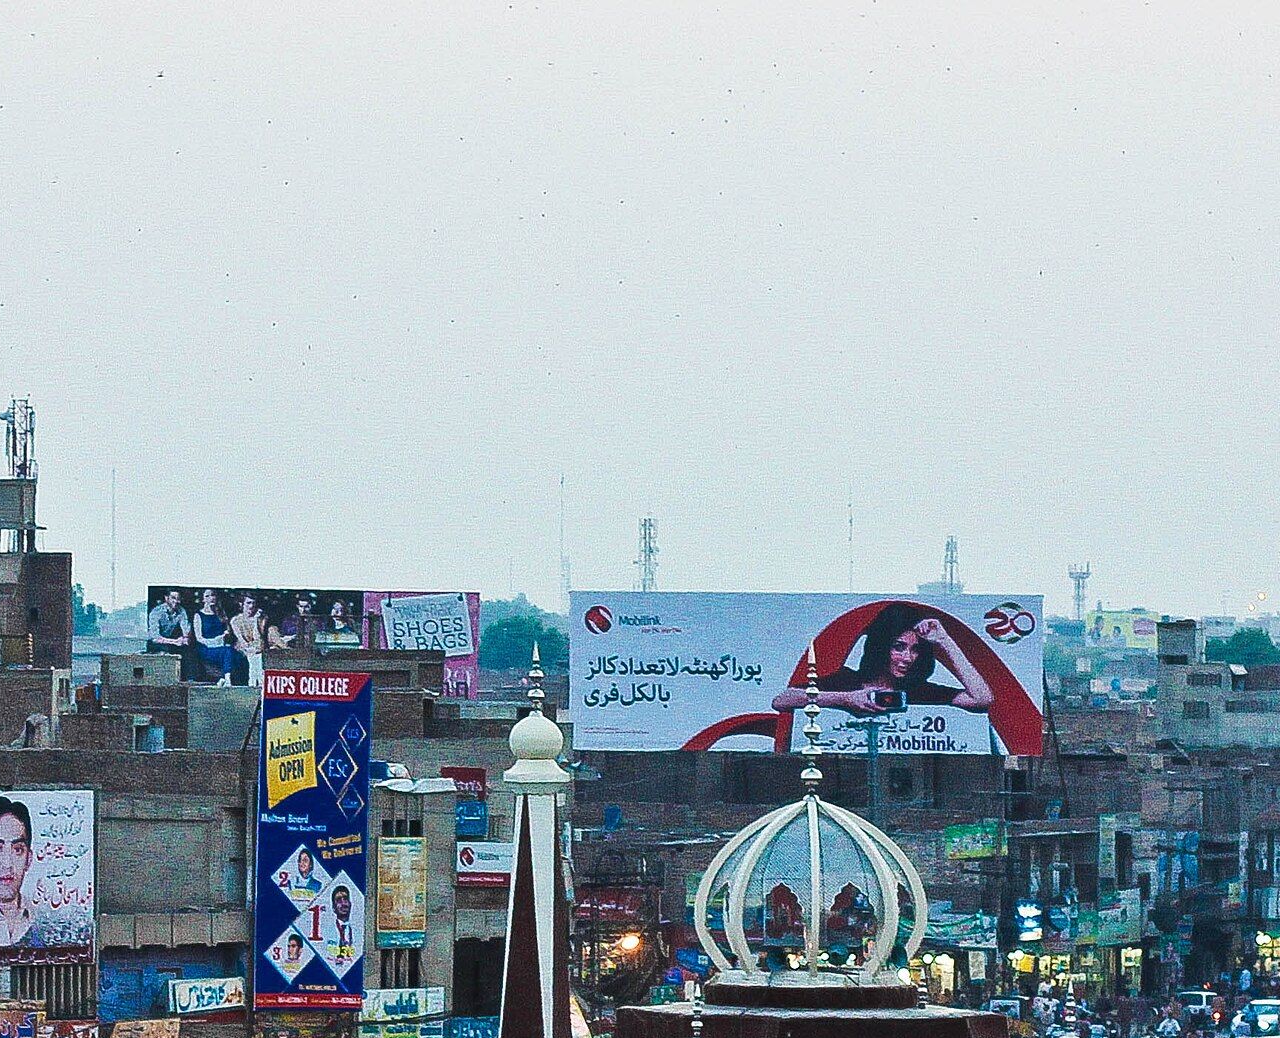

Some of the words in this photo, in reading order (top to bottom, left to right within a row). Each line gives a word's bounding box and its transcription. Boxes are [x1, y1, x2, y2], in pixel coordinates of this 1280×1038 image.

[393, 617, 465, 638] SHOES
[420, 633, 469, 650] BAGS
[585, 655, 619, 681] کالز
[732, 655, 763, 685] پورا
[267, 675, 296, 694] KIPS
[300, 676, 350, 697] COLLEGE
[584, 683, 620, 708] فری
[620, 682, 671, 709] بالکل
[921, 716, 946, 733] 20
[269, 736, 313, 761] Admission
[886, 735, 956, 751] Mobilink
[278, 758, 305, 782] OPEN
